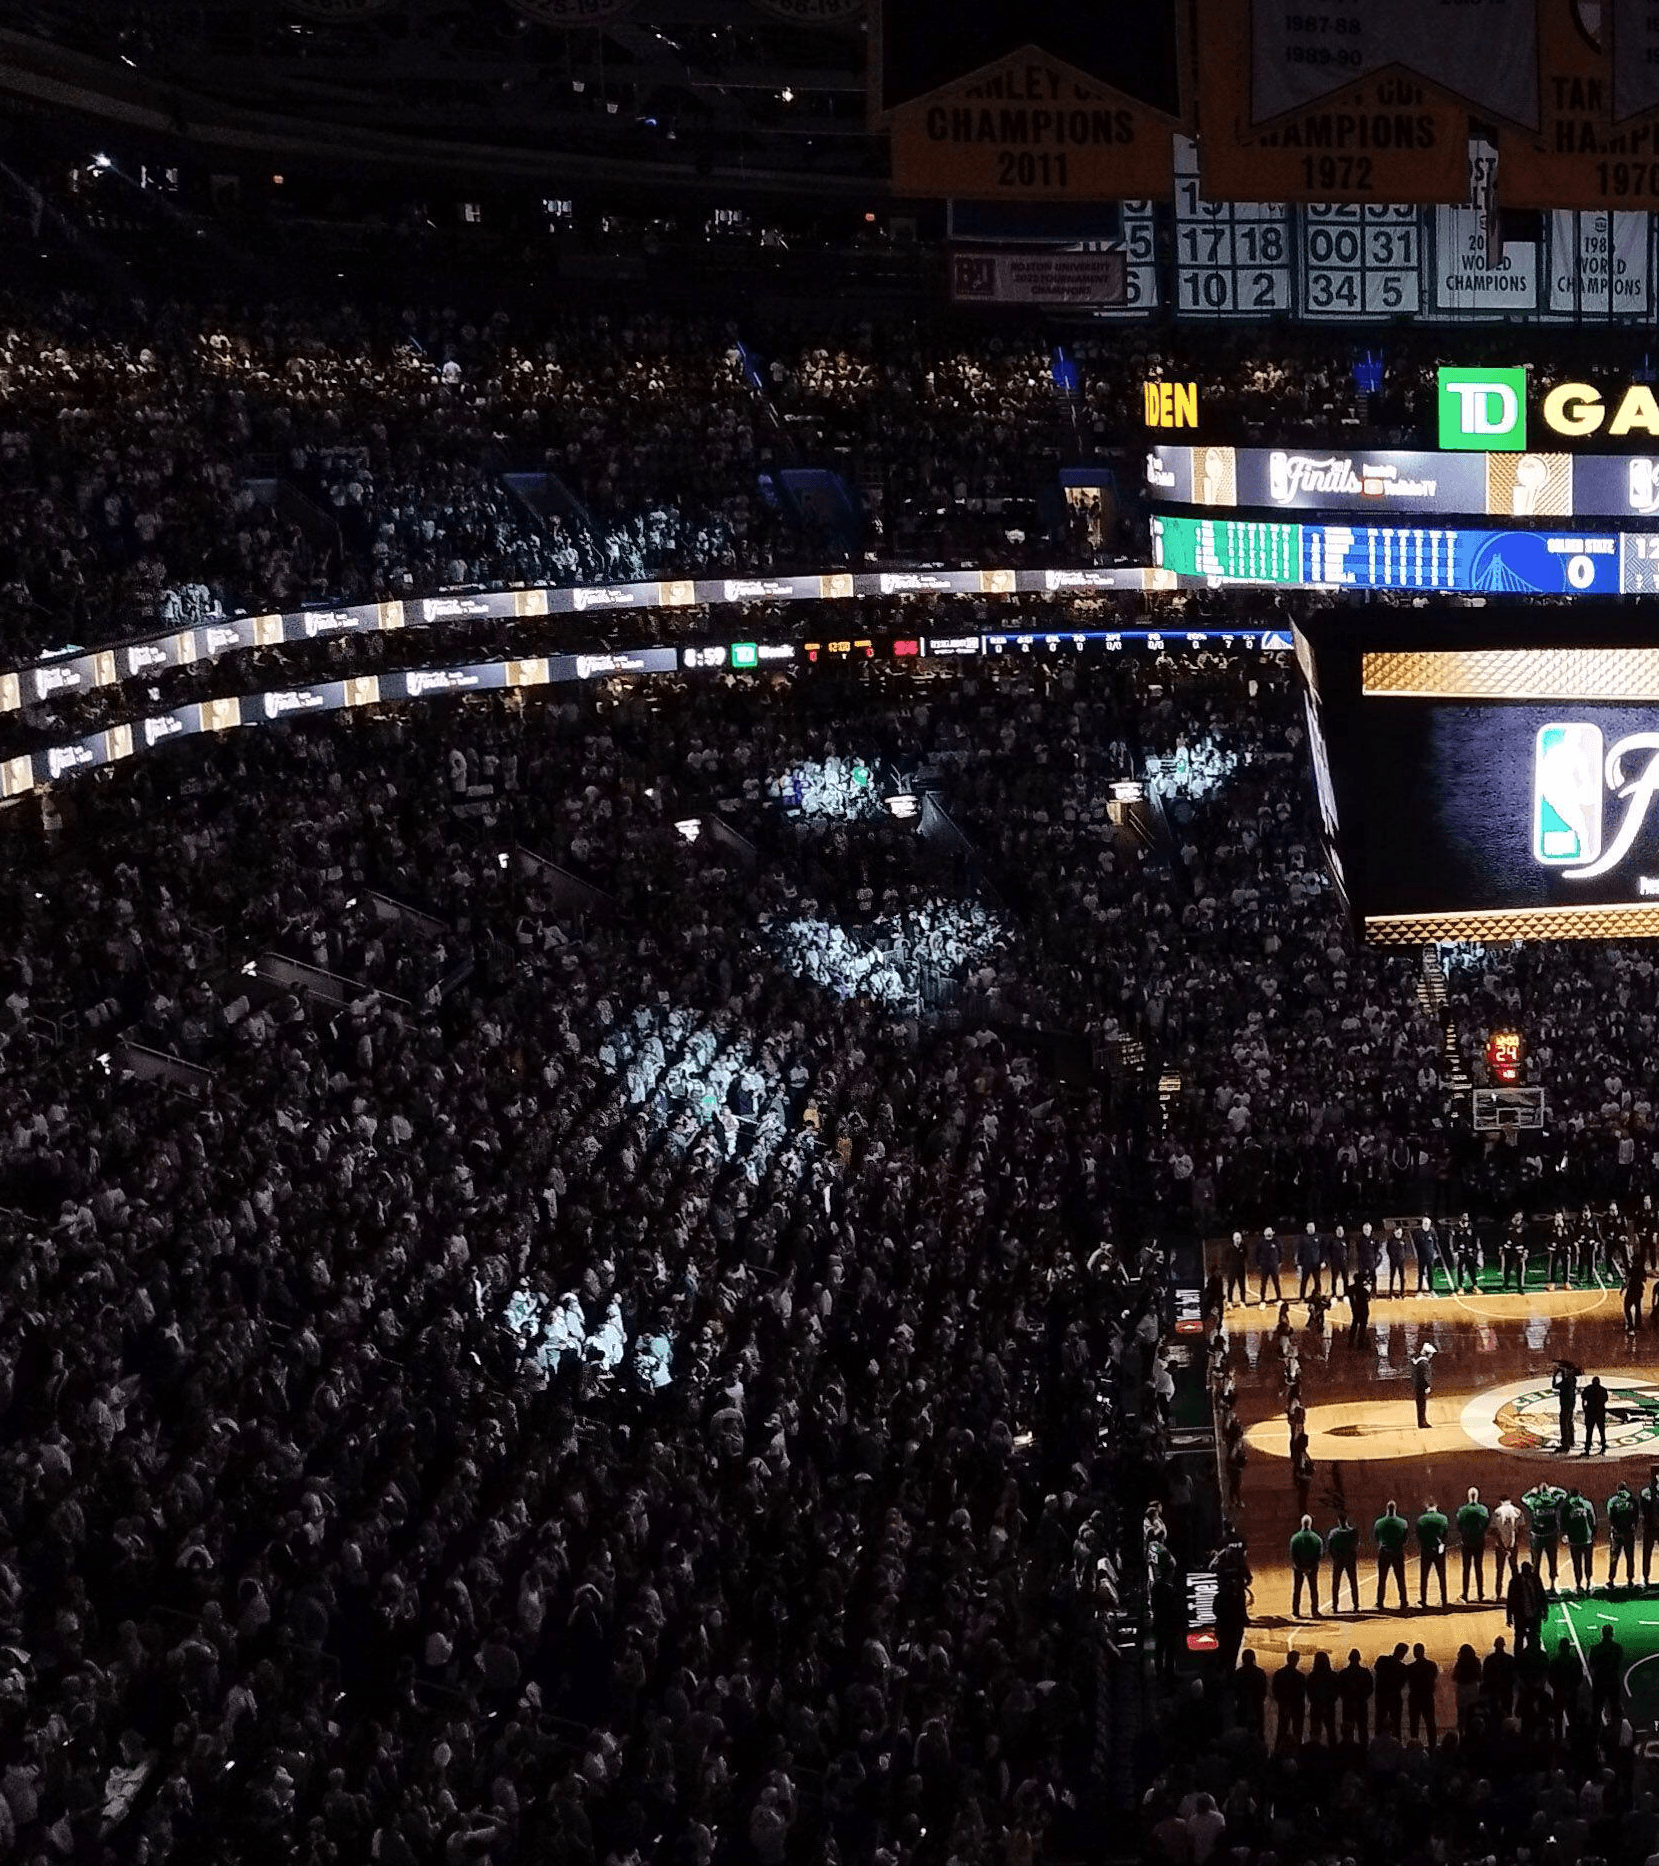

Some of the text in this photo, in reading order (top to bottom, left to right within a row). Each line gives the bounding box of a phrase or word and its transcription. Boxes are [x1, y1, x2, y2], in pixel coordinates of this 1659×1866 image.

[1285, 15, 1362, 36] 1987-88
[1285, 46, 1363, 67] 1989-90
[926, 106, 1135, 146] CHAMPIONS
[998, 150, 1067, 188] 2011
[1301, 156, 1374, 190] 1972
[1183, 227, 1283, 262] 17 18
[1310, 229, 1412, 263] 00 31
[1184, 273, 1276, 307] 10 2
[1312, 274, 1402, 307] 34 5
[1446, 276, 1527, 292] CHAMPIONS
[1446, 382, 1518, 434] TD
[1568, 555, 1595, 589] 0
[1495, 1045, 1517, 1062] 24
